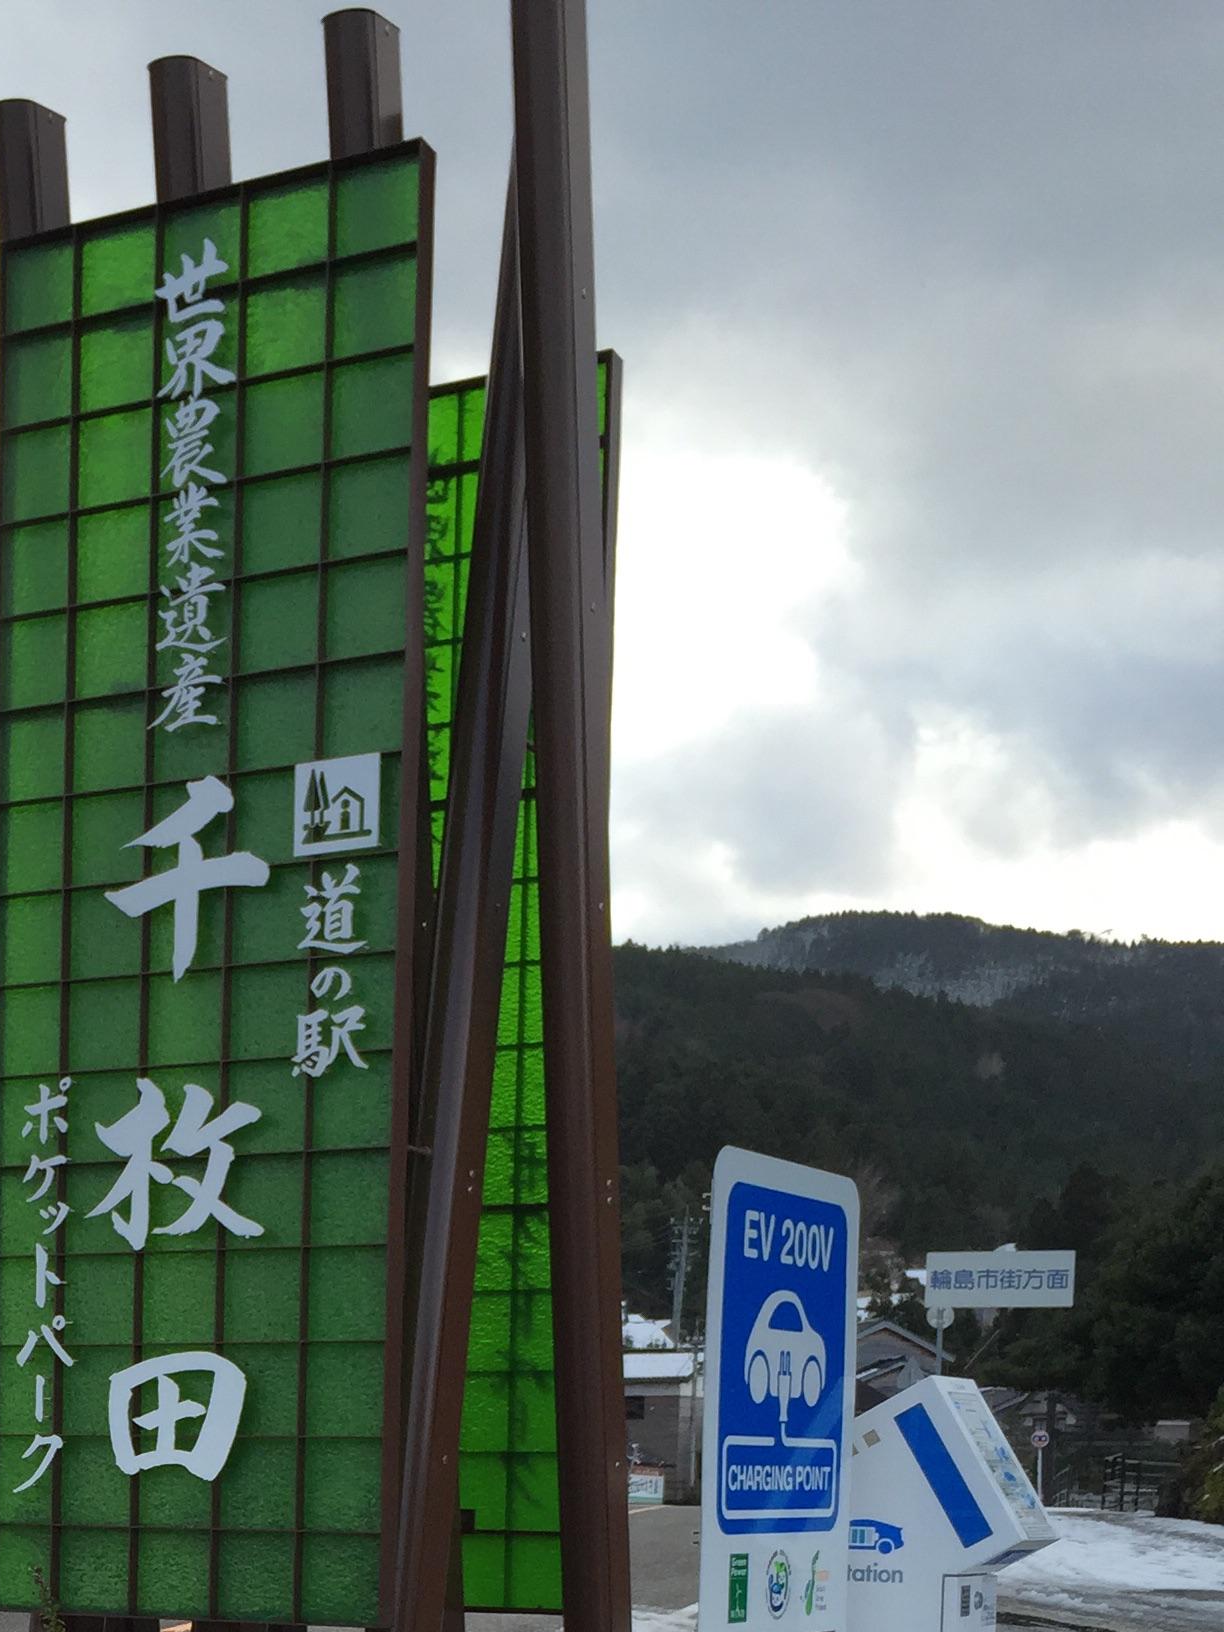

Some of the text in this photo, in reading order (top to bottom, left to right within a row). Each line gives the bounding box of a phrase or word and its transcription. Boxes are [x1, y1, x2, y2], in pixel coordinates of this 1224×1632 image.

[146, 237, 237, 732] 世界農業遺産
[291, 863, 370, 1078] 道の駅
[84, 774, 271, 1482] 千枚田
[12, 1076, 74, 1493] ポケットパーク
[743, 1209, 835, 1272] EV 200V
[930, 1269, 1071, 1291] 輪島市街方面
[727, 1464, 832, 1491] CHARGING POINT
